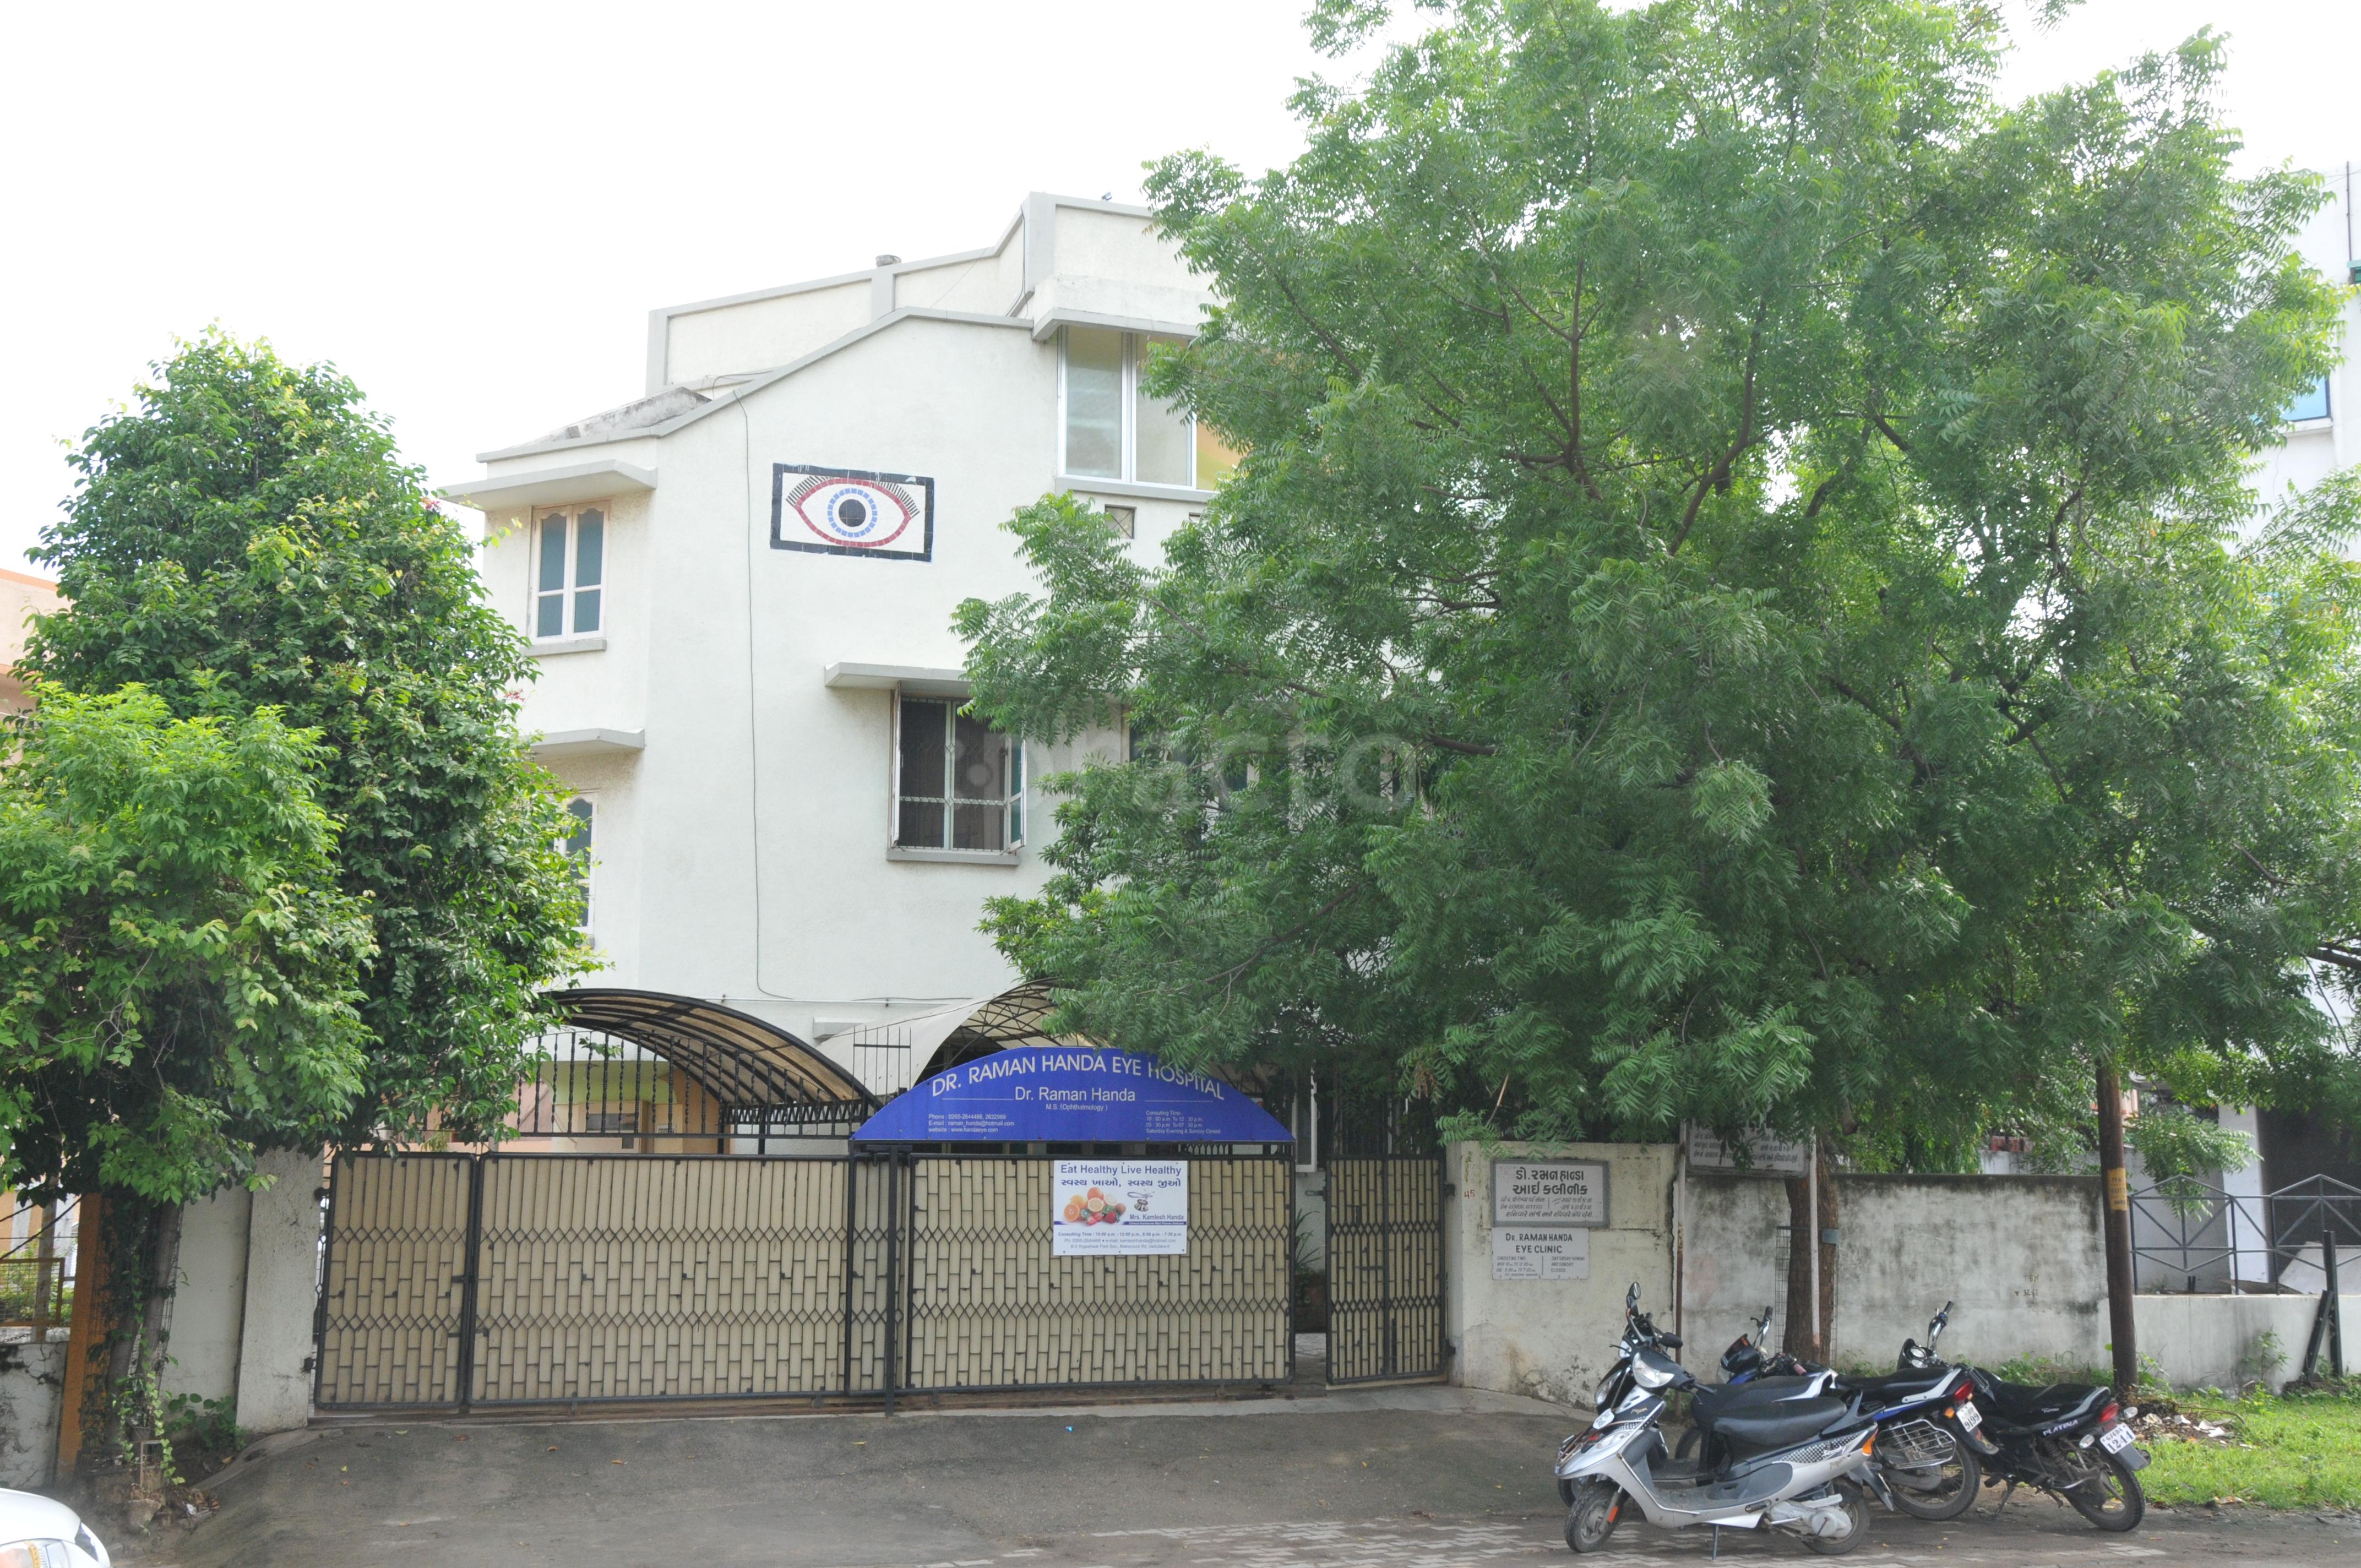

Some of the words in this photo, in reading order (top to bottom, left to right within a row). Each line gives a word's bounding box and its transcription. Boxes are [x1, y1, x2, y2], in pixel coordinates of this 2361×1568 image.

[932, 1073, 961, 1097] DR.
[969, 1056, 1036, 1085] RAMAN
[1042, 1054, 1107, 1072] HANDA
[1112, 1057, 1141, 1076] EYE
[1148, 1061, 1224, 1100] HOSPITAL
[1015, 1086, 1033, 1101] Dr.
[1039, 1087, 1086, 1101] Raman
[1092, 1087, 1136, 1101] Handa
[1061, 1164, 1077, 1174] Eat
[1081, 1164, 1118, 1176] Healthy
[1121, 1165, 1141, 1174] Live
[1145, 1165, 1182, 1177] Healthy
[1531, 1169, 1558, 1180] રમન
[1560, 1170, 1584, 1182] હાન્ડા
[1519, 1233, 1547, 1242] RAMAN
[1549, 1234, 1573, 1242] HANDA
[1515, 1245, 1532, 1254] EYE
[1534, 1245, 1563, 1254] CLINIC
[1964, 1413, 1980, 1430] 9199
[2042, 1419, 2079, 1436] PLATINA
